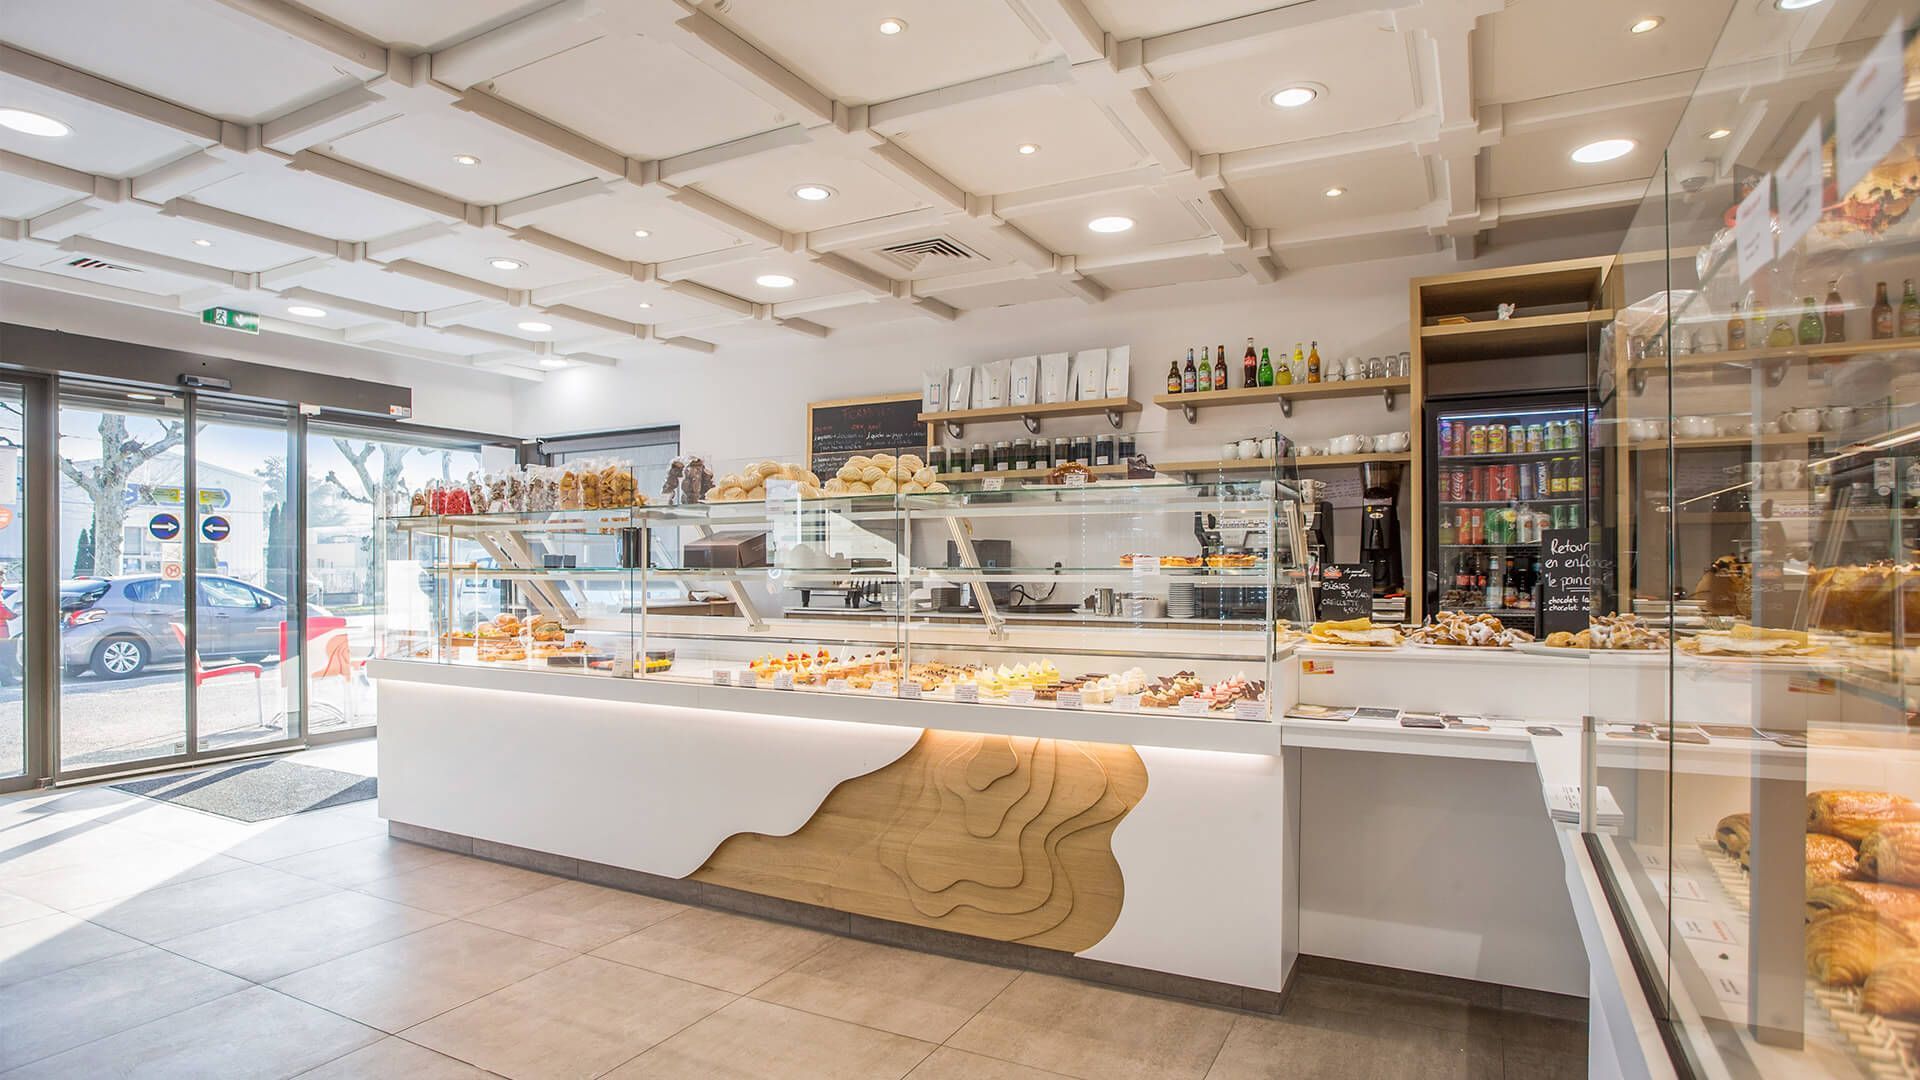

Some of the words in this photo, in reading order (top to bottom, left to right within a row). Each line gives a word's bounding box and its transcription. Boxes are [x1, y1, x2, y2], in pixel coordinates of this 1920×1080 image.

[1551, 538, 1590, 555] Retour
[1545, 559, 1558, 568] en
[1548, 595, 1579, 605] chocolat
[1548, 603, 1578, 612] chocolat
